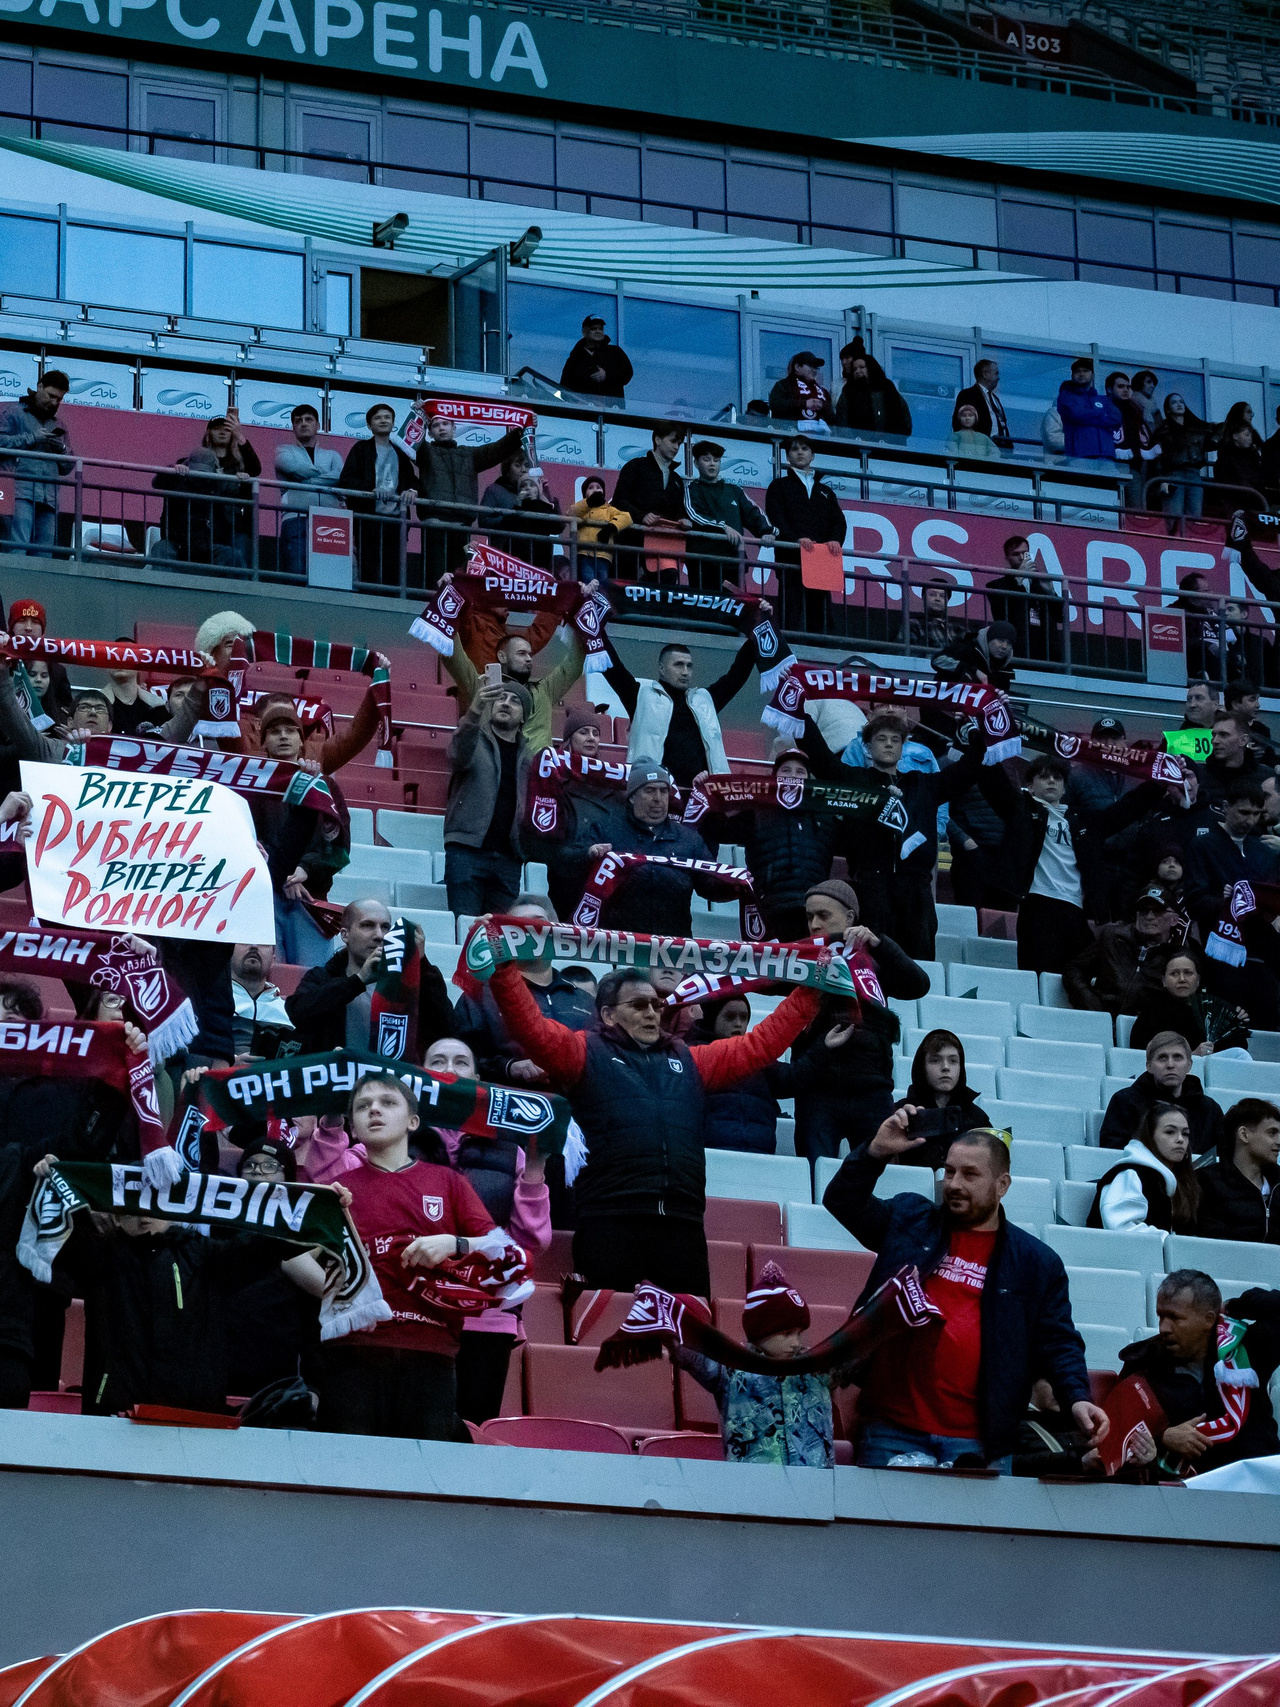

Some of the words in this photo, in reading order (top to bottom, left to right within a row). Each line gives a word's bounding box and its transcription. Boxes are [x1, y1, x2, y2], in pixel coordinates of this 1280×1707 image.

[247, 0, 549, 89] АРЕНА
[1026, 34, 1061, 54] 303
[470, 405, 529, 425] РУБИН
[485, 577, 558, 596] РУБИН
[505, 593, 538, 602] КАЗАНЬ
[424, 609, 455, 637] 1958
[12, 636, 97, 659] РУБИН
[106, 647, 204, 668] КАЗАНЬ
[870, 675, 987, 708] РУБИН
[107, 739, 279, 789] РУБИН
[704, 781, 770, 796] РУБИН
[724, 793, 754, 802] КАЗАНЬ
[811, 786, 880, 806] РУБИН
[827, 800, 859, 809] КАЗАНЬ
[503, 925, 629, 965] РУБИН
[648, 937, 810, 981] КАЗАНЬ
[110, 1164, 315, 1232] RUBIN
